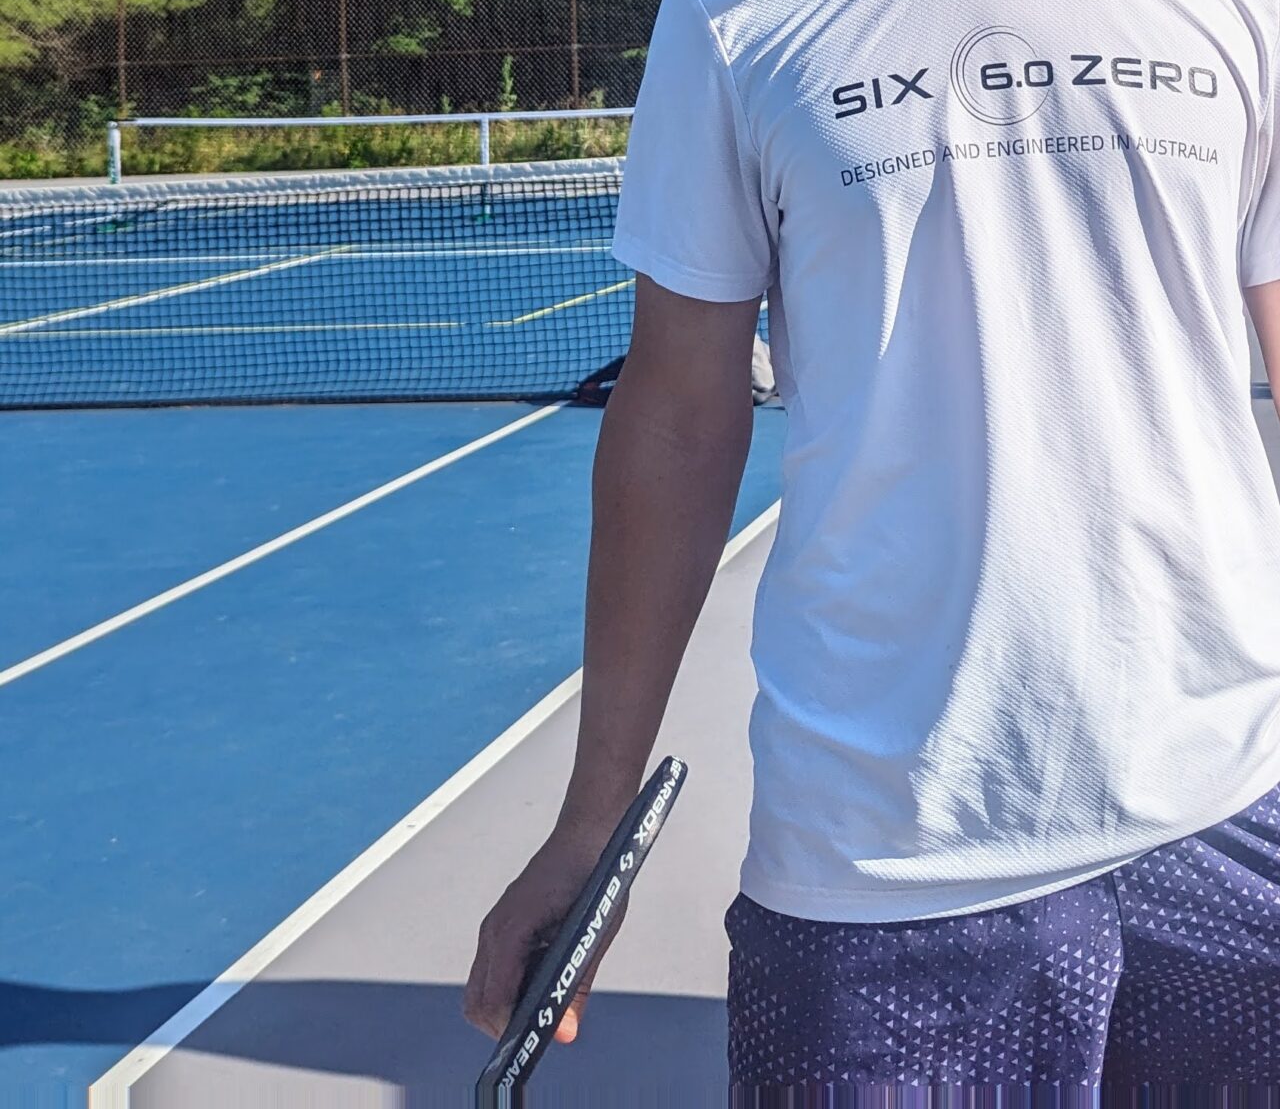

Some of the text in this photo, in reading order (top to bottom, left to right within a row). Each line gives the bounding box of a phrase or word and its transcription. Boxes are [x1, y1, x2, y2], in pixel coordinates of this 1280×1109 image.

[832, 54, 1218, 119] SIX 6.0 ZERO
[840, 134, 1219, 187] DESIGNED AND ENGINEERED IN AUSTRALIA
[633, 759, 682, 846] GEARBOX
[550, 878, 622, 1005] GEARBOX
[499, 1030, 540, 1087] GEAR
